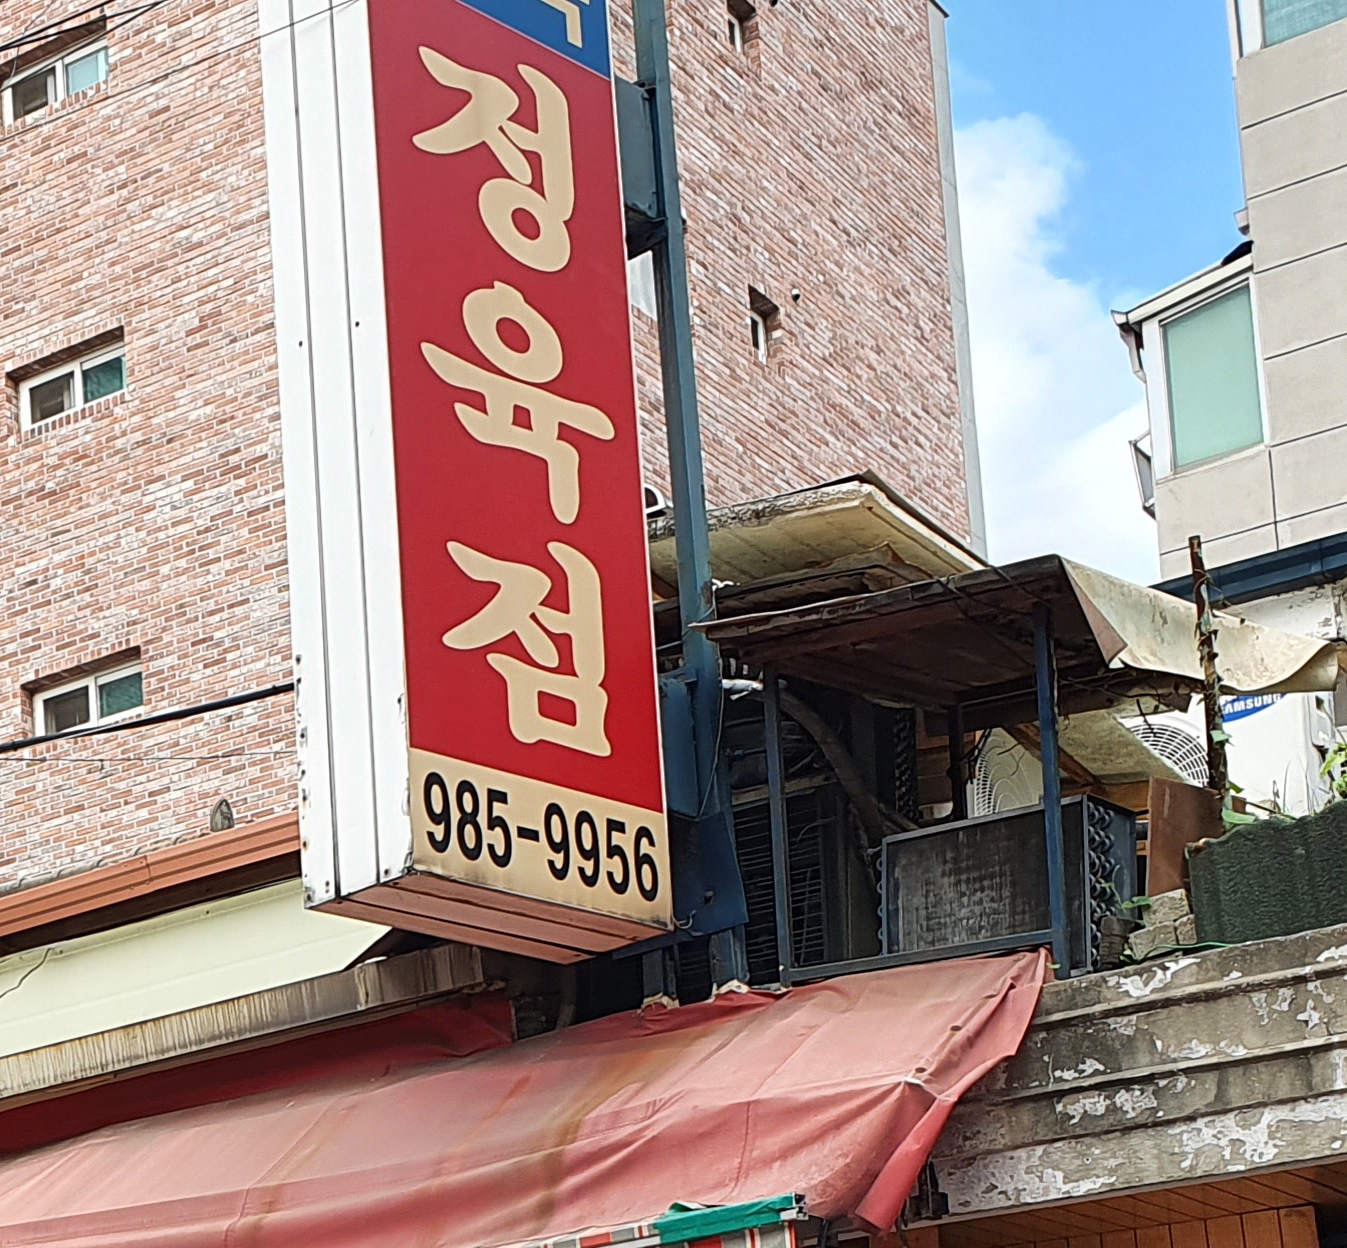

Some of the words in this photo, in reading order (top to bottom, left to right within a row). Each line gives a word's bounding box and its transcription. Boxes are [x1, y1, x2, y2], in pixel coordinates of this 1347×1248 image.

[411, 45, 616, 759] 정육점
[1222, 693, 1282, 714] AMSUNG
[423, 770, 660, 903] 985-9956
